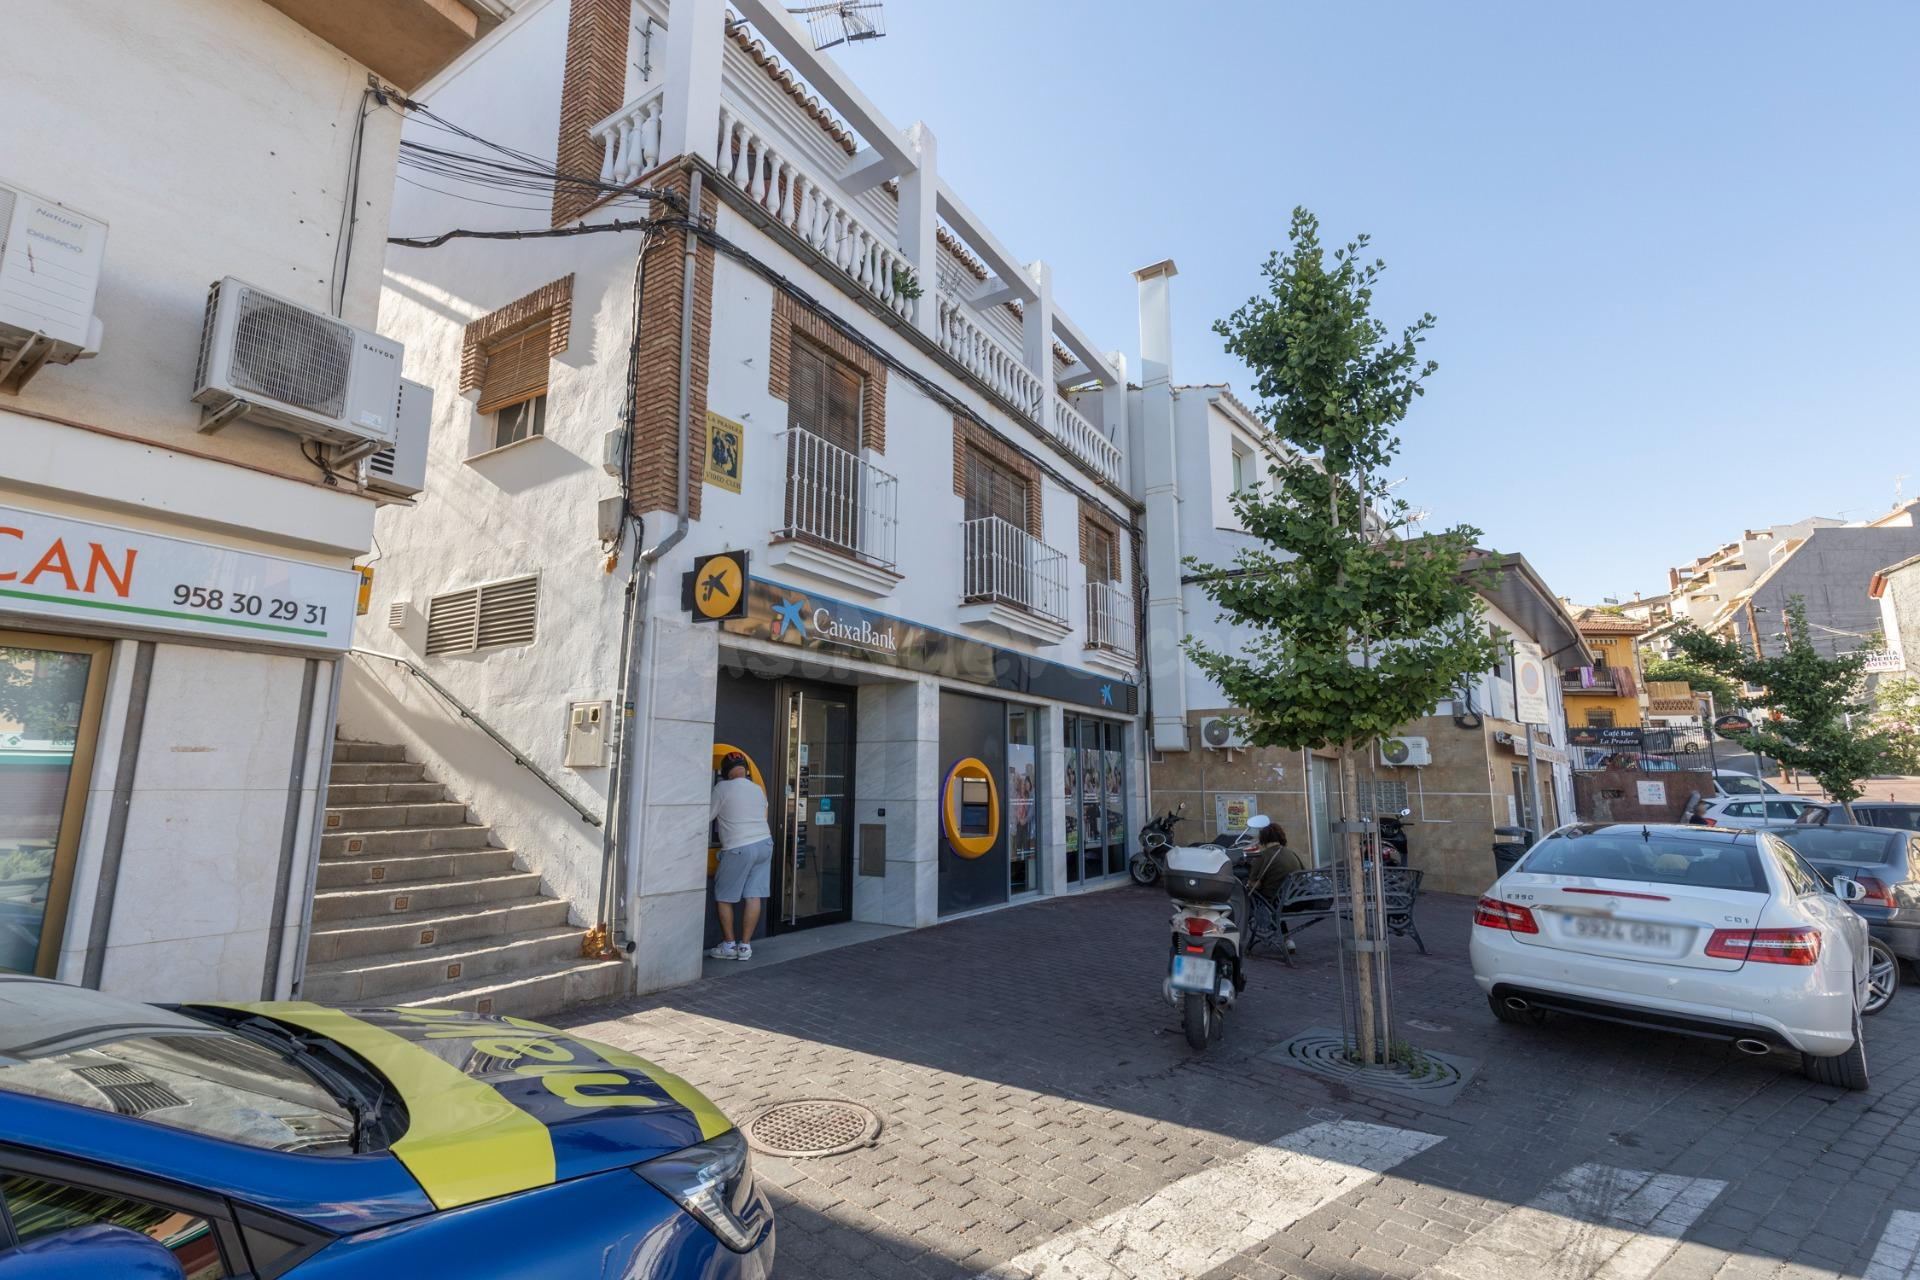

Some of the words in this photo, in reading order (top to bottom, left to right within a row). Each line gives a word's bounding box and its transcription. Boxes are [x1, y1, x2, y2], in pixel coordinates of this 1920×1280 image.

[36, 207, 83, 230] Natural
[173, 583, 224, 611] 958
[229, 592, 263, 616] 30
[269, 598, 298, 622] 29
[303, 604, 327, 626] 31
[813, 607, 897, 651] CaixaBank
